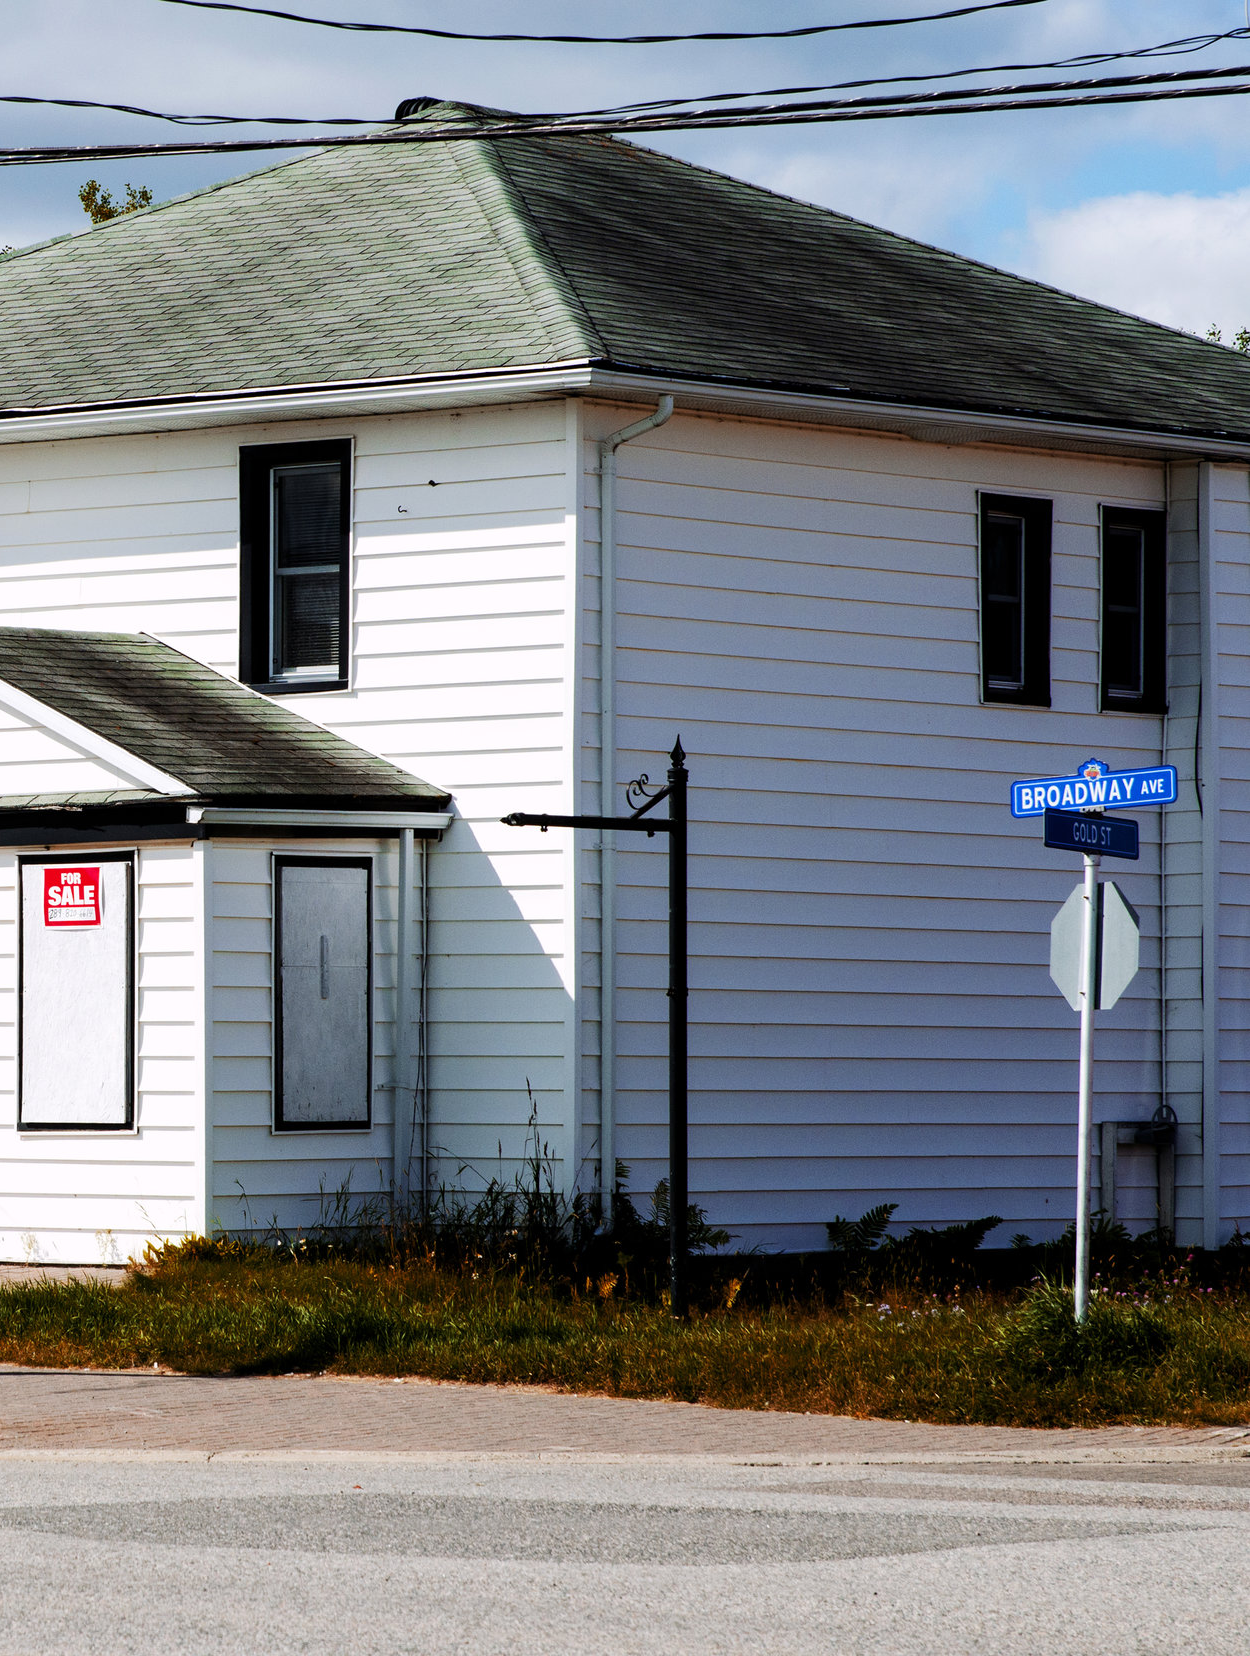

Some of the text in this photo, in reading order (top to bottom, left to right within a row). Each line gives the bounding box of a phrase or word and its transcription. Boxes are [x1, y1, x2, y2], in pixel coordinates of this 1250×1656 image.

[1021, 777, 1164, 809] BROADWAY AVE
[1073, 822, 1112, 846] GOLD ST
[61, 872, 81, 885] FOR
[48, 885, 95, 906] SALE
